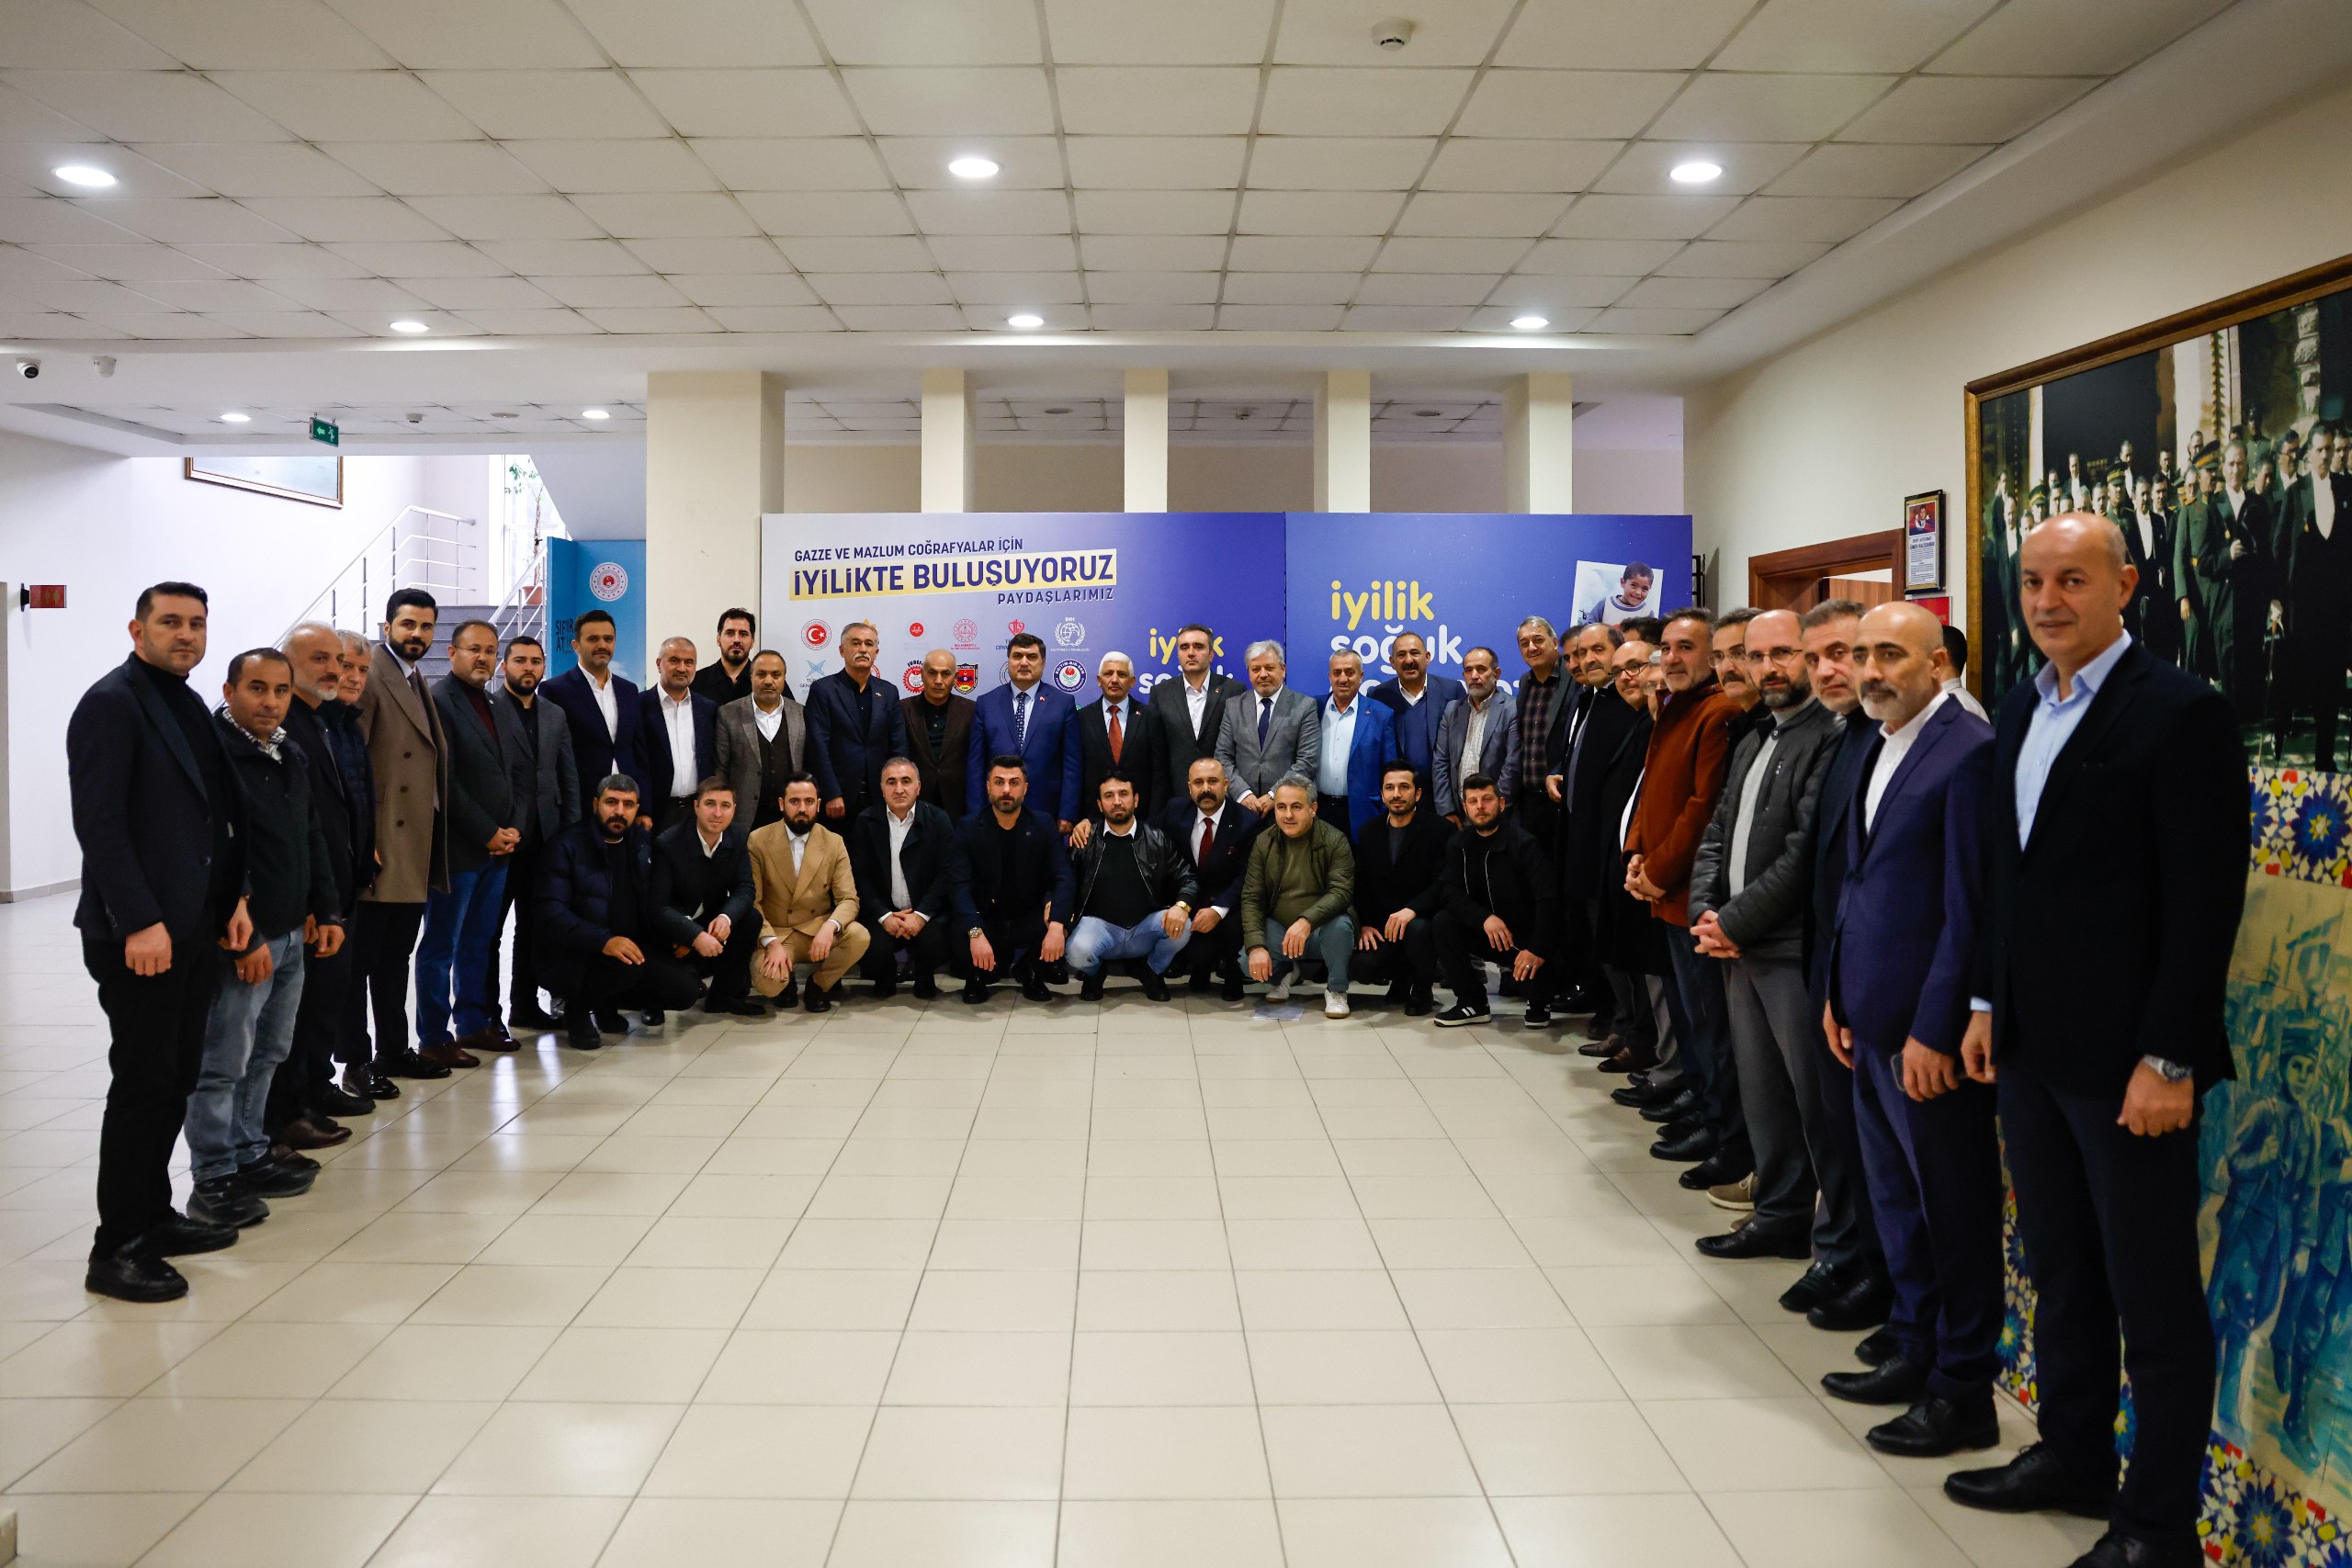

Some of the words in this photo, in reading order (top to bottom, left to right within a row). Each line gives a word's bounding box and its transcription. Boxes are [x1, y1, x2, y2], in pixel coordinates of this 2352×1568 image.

[795, 548, 831, 561] GAZZE
[835, 547, 850, 559] VE
[854, 545, 904, 558] MAZLUM
[908, 540, 995, 556] COĞRAFYALAR
[999, 536, 1023, 553] İÇİN
[794, 565, 904, 595] İYİLİKTE
[913, 555, 1114, 589] BULUŞUYORUZ
[998, 588, 1114, 605] PAYDAŞLARIMIZ
[1331, 580, 1435, 631] iyilik
